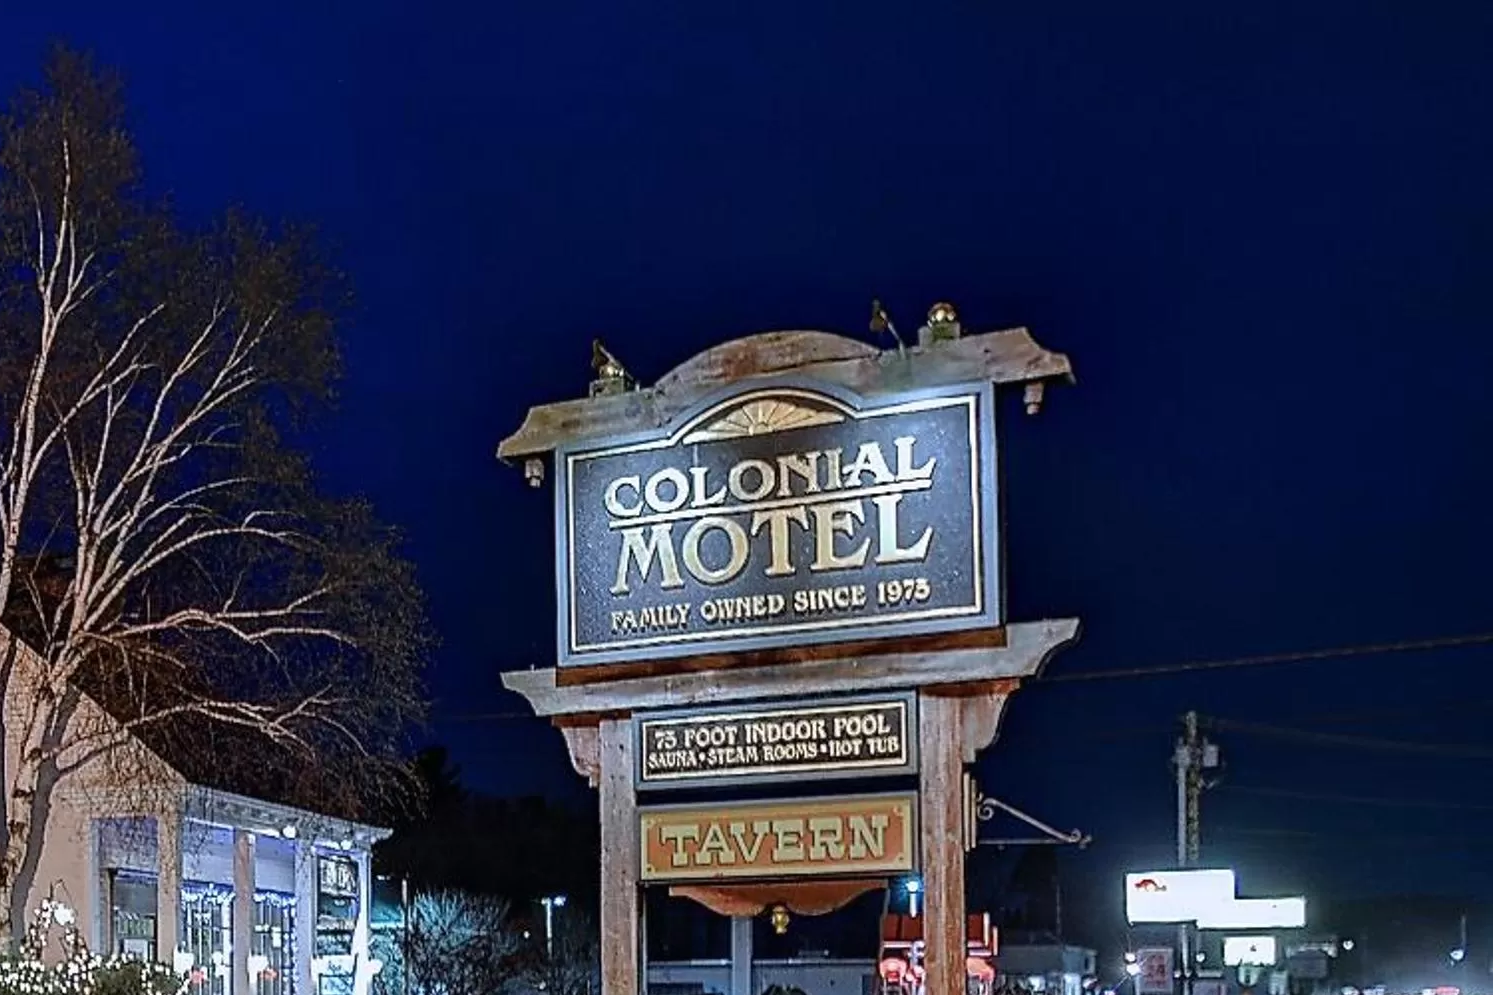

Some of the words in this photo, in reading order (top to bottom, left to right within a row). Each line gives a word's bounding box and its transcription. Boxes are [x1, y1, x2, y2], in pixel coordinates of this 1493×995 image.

[604, 436, 937, 518] COLONIAL
[610, 493, 933, 595] MOTEL
[610, 602, 691, 629] FAMILY
[700, 593, 785, 621] OWNED
[793, 584, 867, 612] SINCE
[877, 578, 931, 604] 1975
[647, 750, 698, 769] SAUNA
[707, 746, 759, 766] STEAM
[763, 739, 818, 762] ROOMS
[828, 737, 863, 758] HOT
[866, 735, 900, 754] TUB
[655, 730, 677, 750] 75
[684, 724, 739, 748] FOOT
[745, 718, 826, 744] INDOOR
[833, 713, 891, 738] POOL
[659, 813, 890, 867] TAVERN
